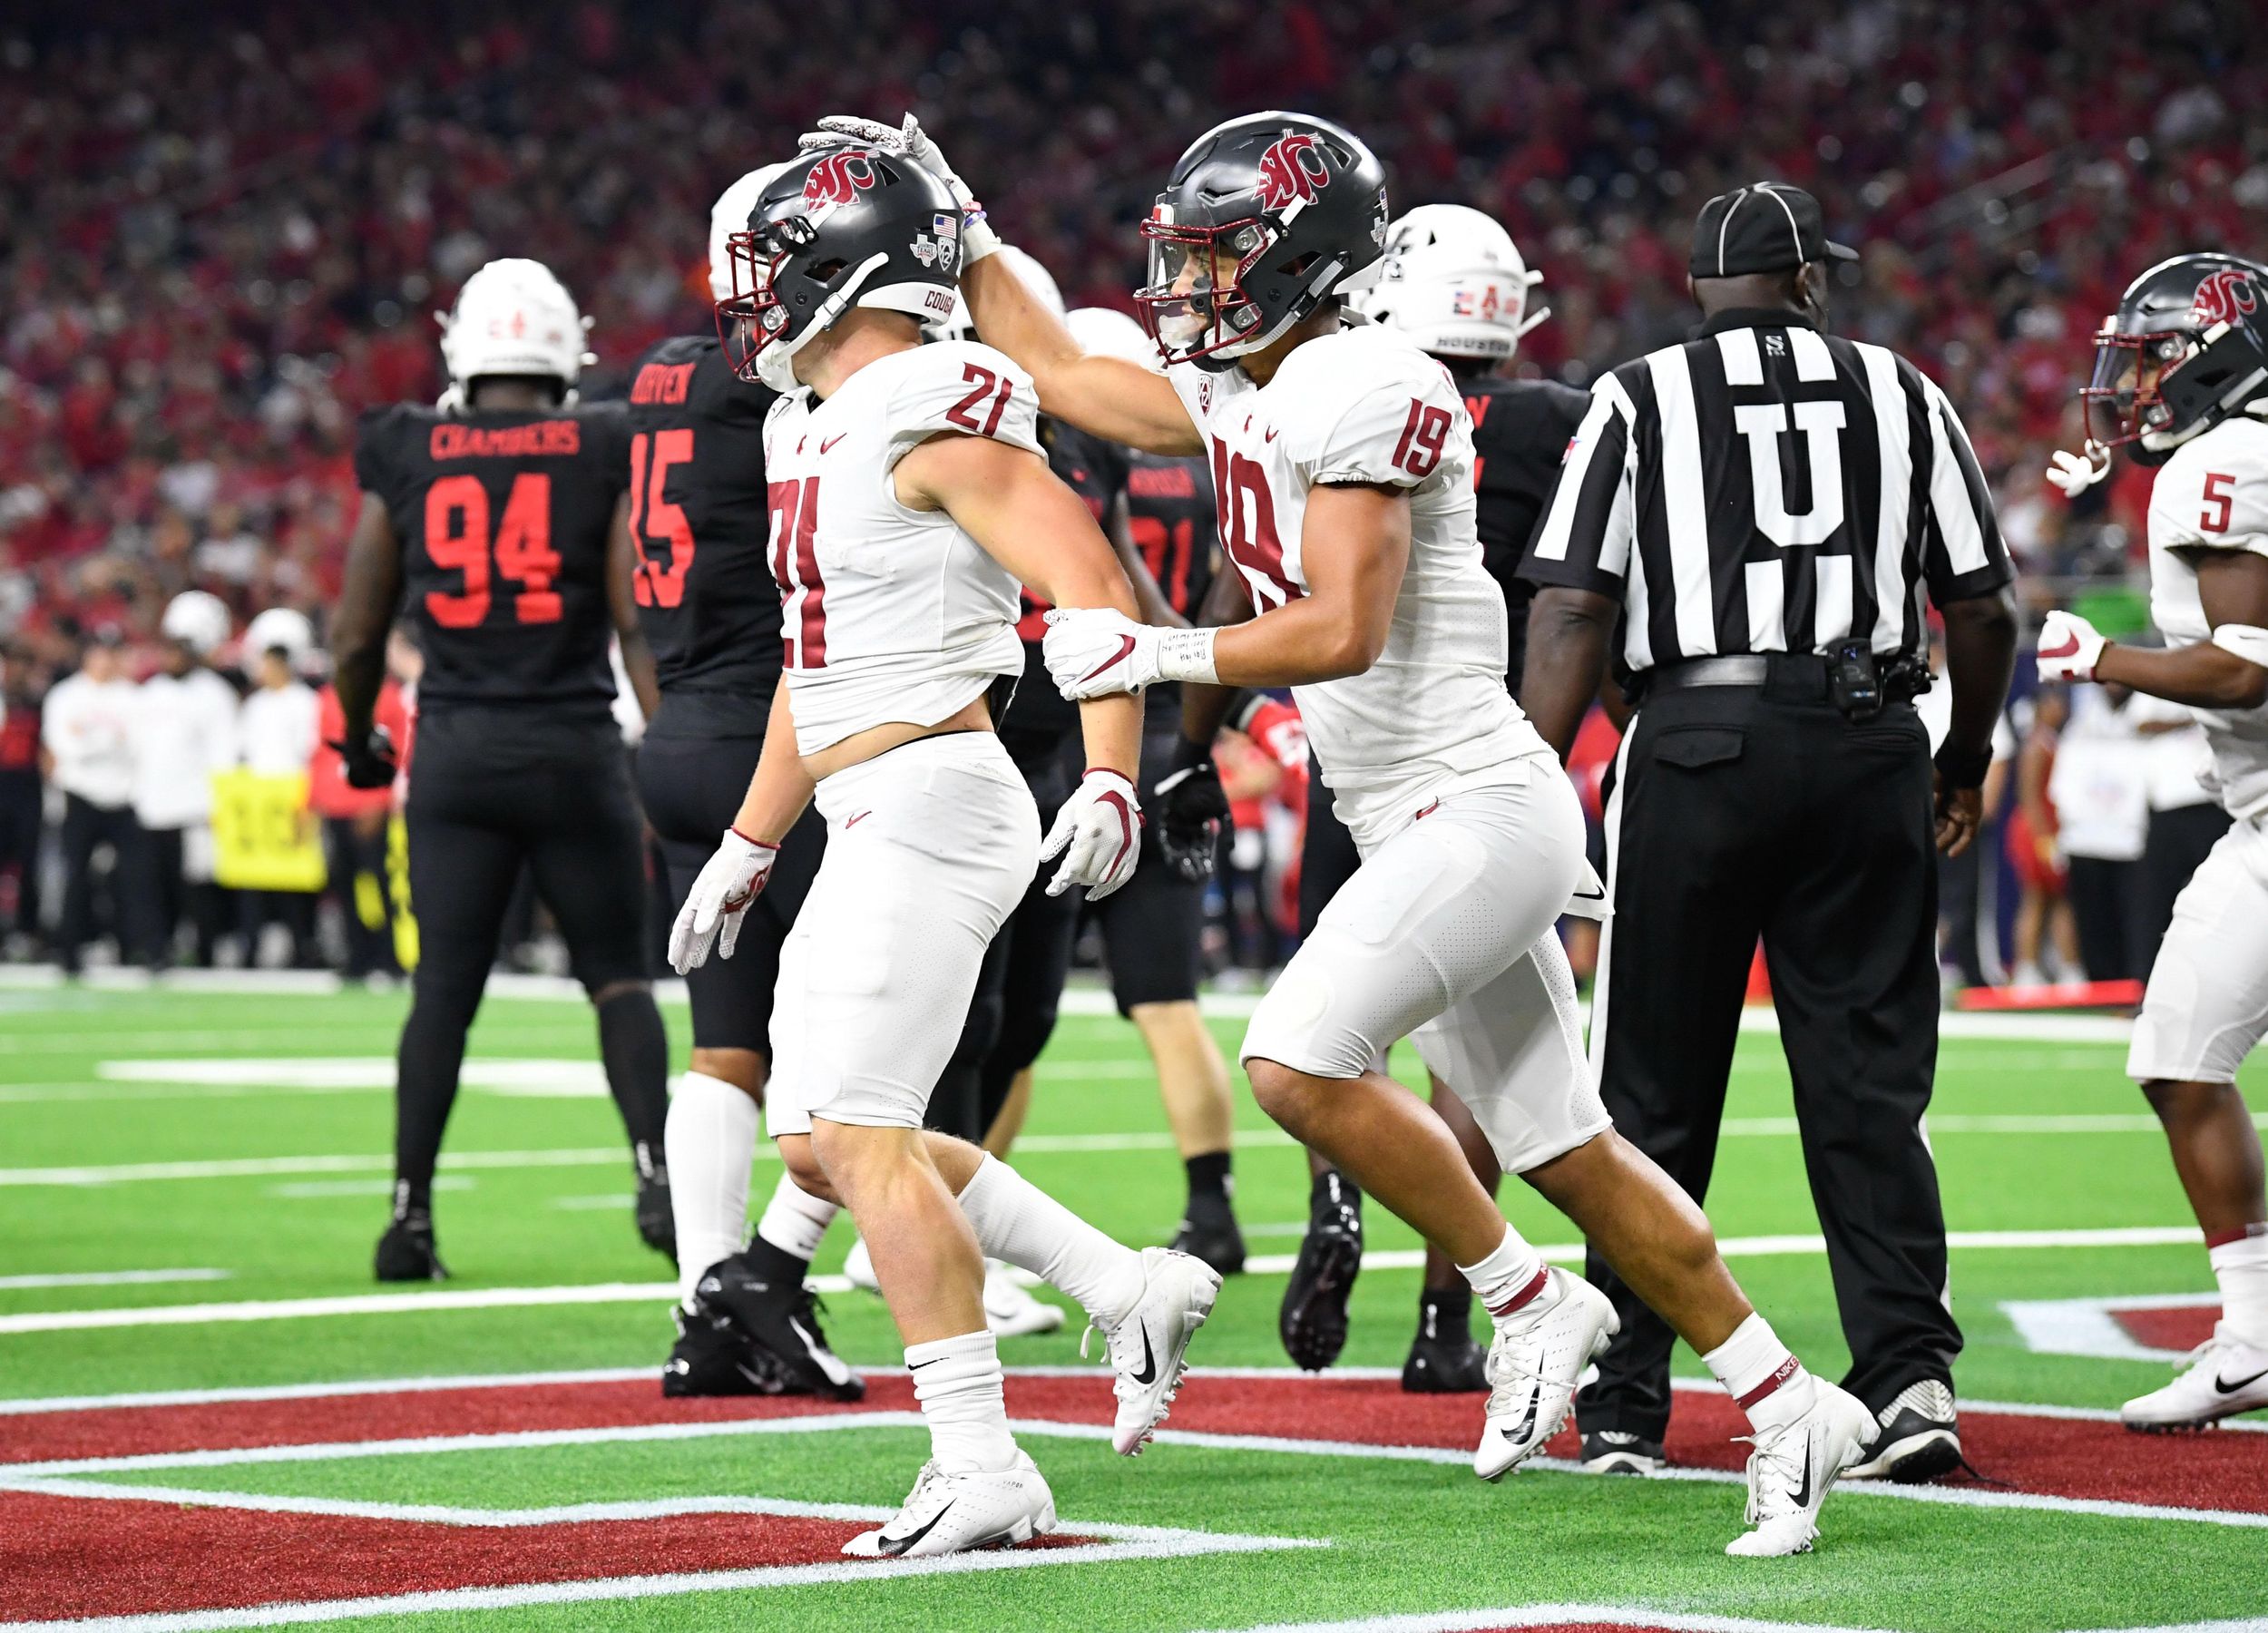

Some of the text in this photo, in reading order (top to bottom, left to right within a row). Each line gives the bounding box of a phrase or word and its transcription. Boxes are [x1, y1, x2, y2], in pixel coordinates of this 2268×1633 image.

[945, 361, 1013, 436] 21
[1391, 397, 1452, 478] 19
[430, 419, 580, 461] CHAMBERS
[1734, 400, 1847, 548] U
[629, 428, 696, 608] 15
[2200, 473, 2236, 533] 5
[425, 473, 563, 628] 94
[1774, 1355, 1798, 1381] NIKE
